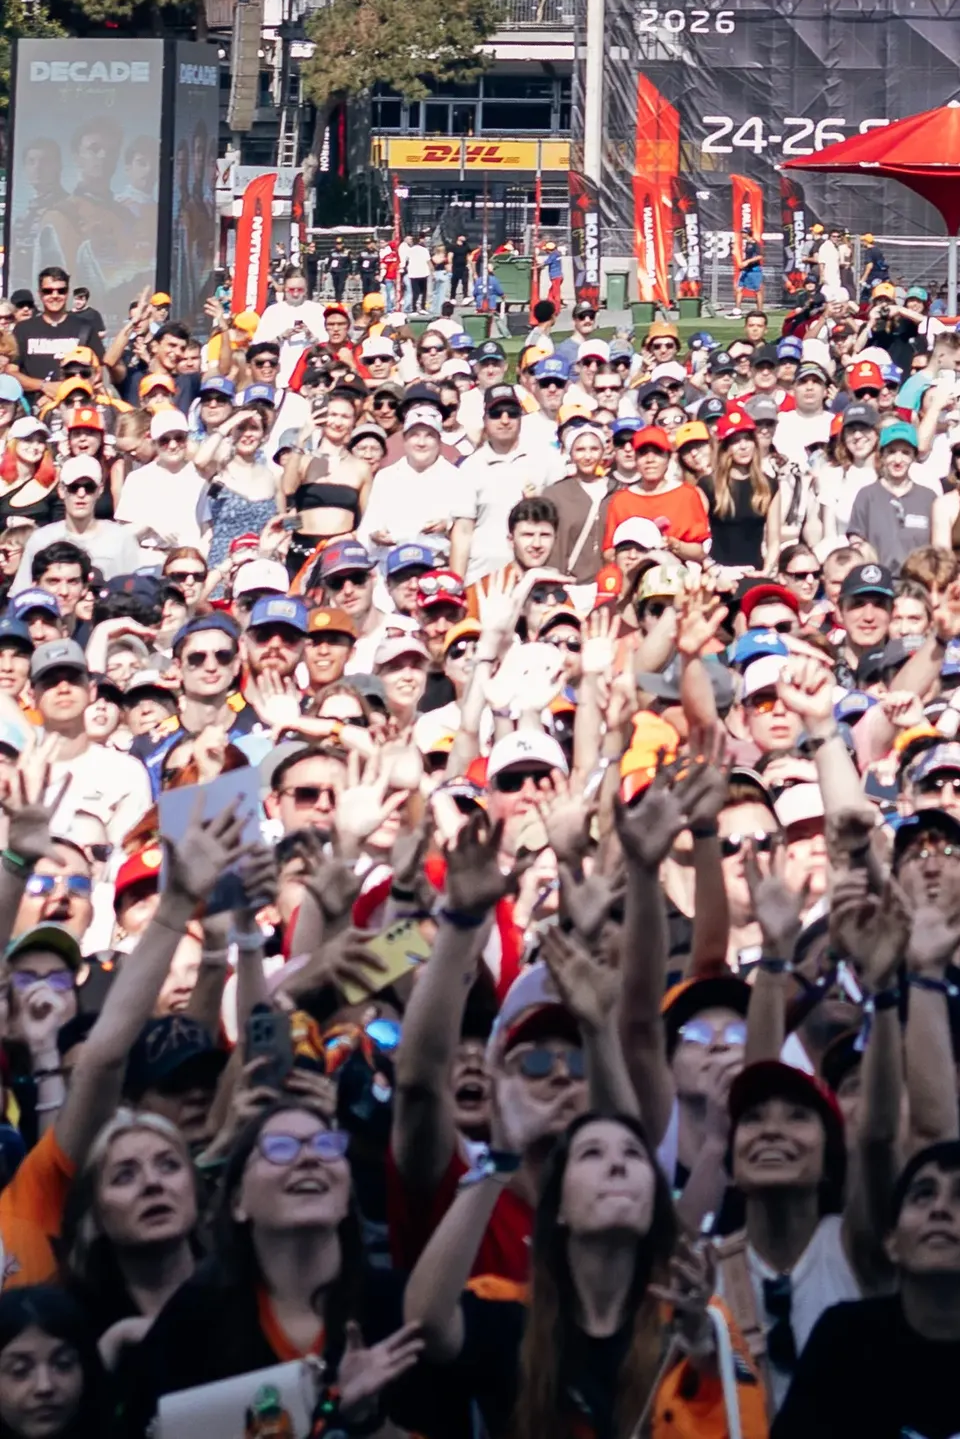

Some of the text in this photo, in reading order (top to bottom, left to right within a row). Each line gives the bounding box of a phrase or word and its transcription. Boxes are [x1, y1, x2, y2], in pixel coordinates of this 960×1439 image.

[640, 9, 736, 34] 2026
[29, 60, 150, 83] DECADE
[179, 63, 217, 86] DECADE
[702, 116, 846, 155] 24-26
[422, 145, 504, 163] DHL
